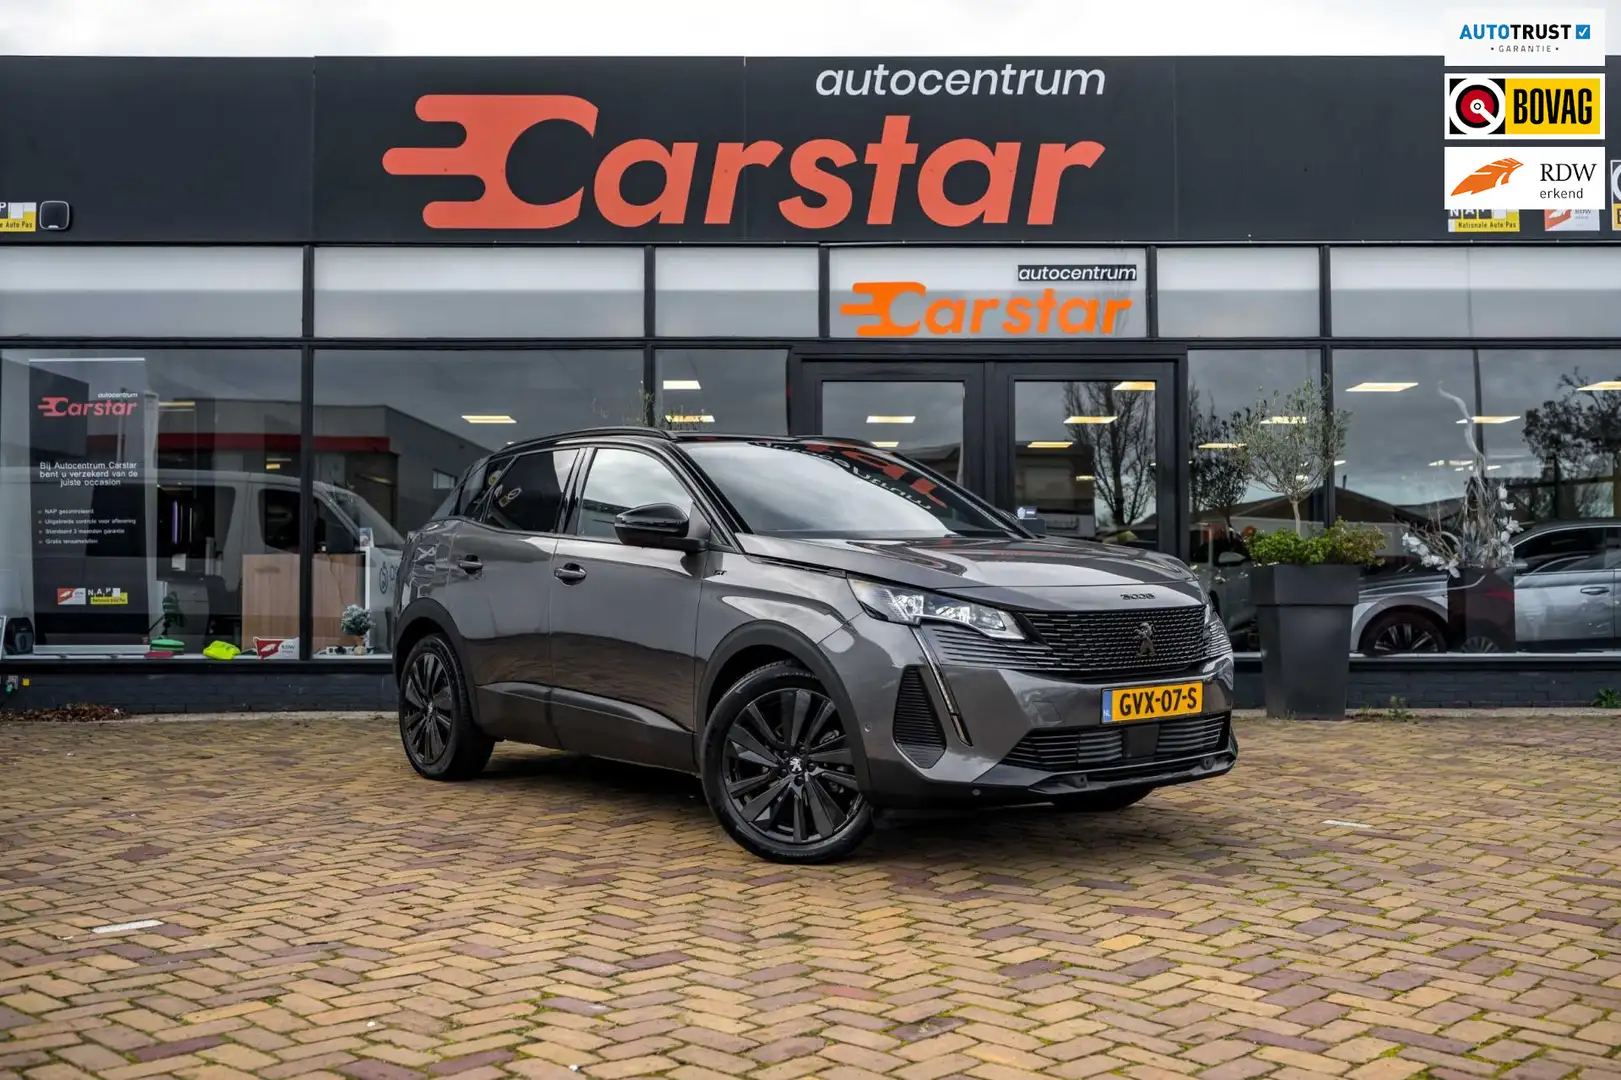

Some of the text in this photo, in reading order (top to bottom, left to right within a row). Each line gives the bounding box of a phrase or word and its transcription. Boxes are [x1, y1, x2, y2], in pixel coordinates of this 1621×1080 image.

[815, 63, 1106, 96] autocentrum
[381, 94, 1106, 230] Carstar
[5, 221, 20, 229] Auto
[21, 221, 33, 229] Pas
[1505, 221, 1517, 229] Pas
[1018, 266, 1137, 280] autocentrum
[839, 282, 1132, 337] Carstar
[38, 397, 138, 417] Carstar
[40, 461, 137, 470] Bij Autocentrum Carstar
[40, 470, 58, 478] bent
[69, 470, 109, 478] verzekerd
[60, 479, 81, 487] juiste
[1120, 687, 1197, 716] GVX-07-S
